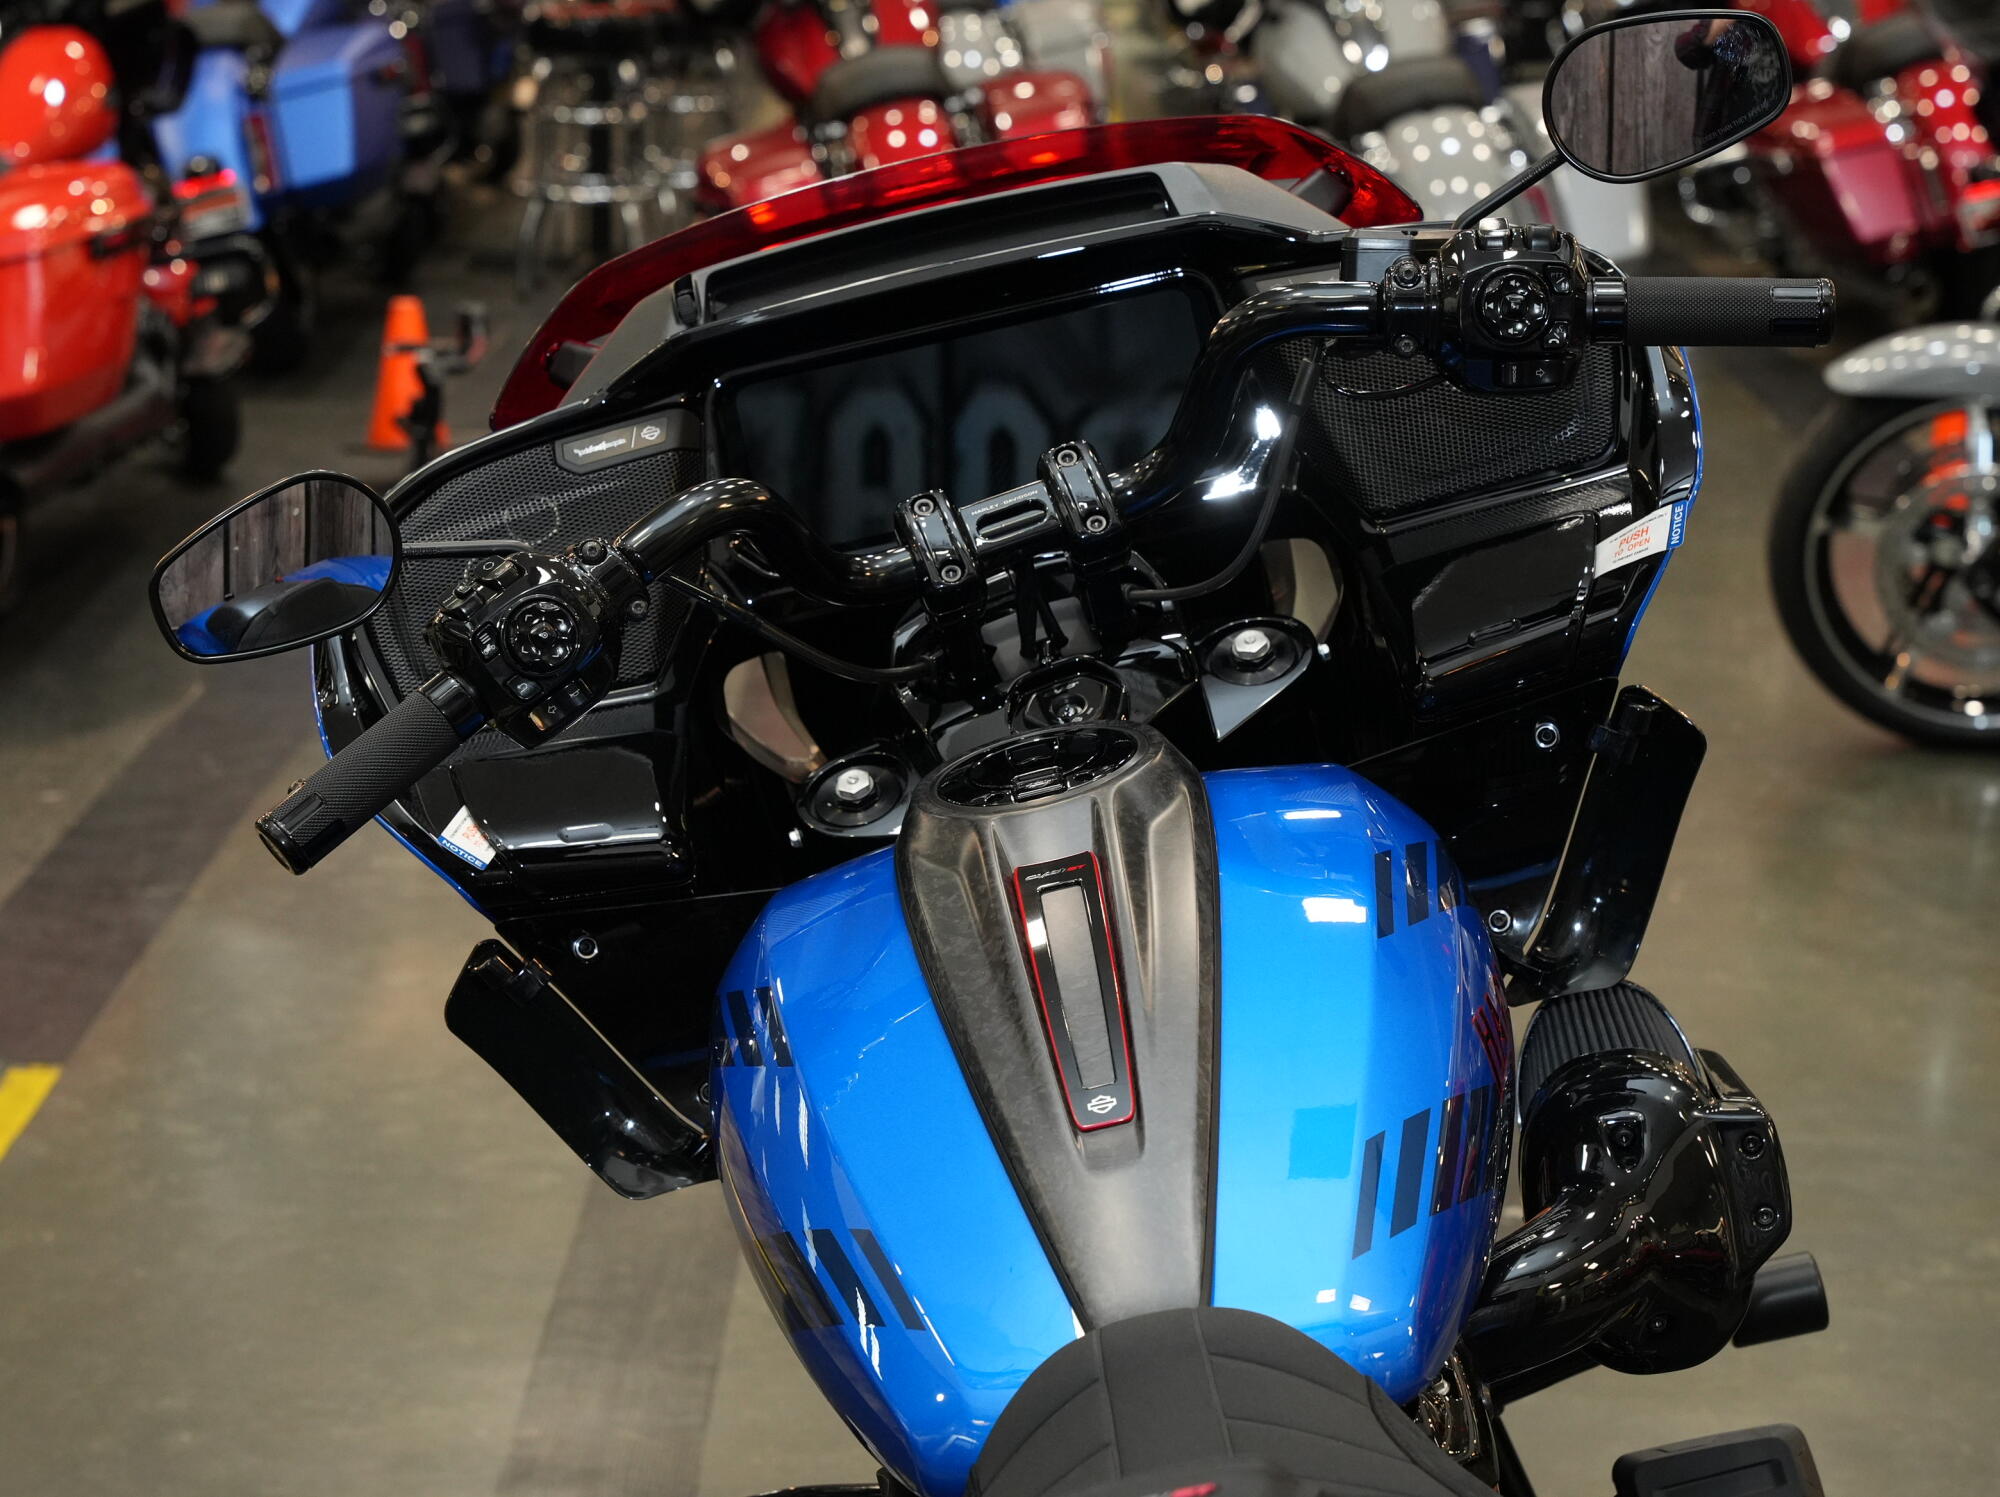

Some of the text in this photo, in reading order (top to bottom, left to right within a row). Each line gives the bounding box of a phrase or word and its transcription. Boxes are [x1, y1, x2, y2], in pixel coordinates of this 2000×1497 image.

[1619, 526, 1649, 548] PUSH
[1670, 505, 1684, 545] NOTICE
[1614, 537, 1650, 558] TO OPEN
[442, 839, 484, 868] NOTICE
